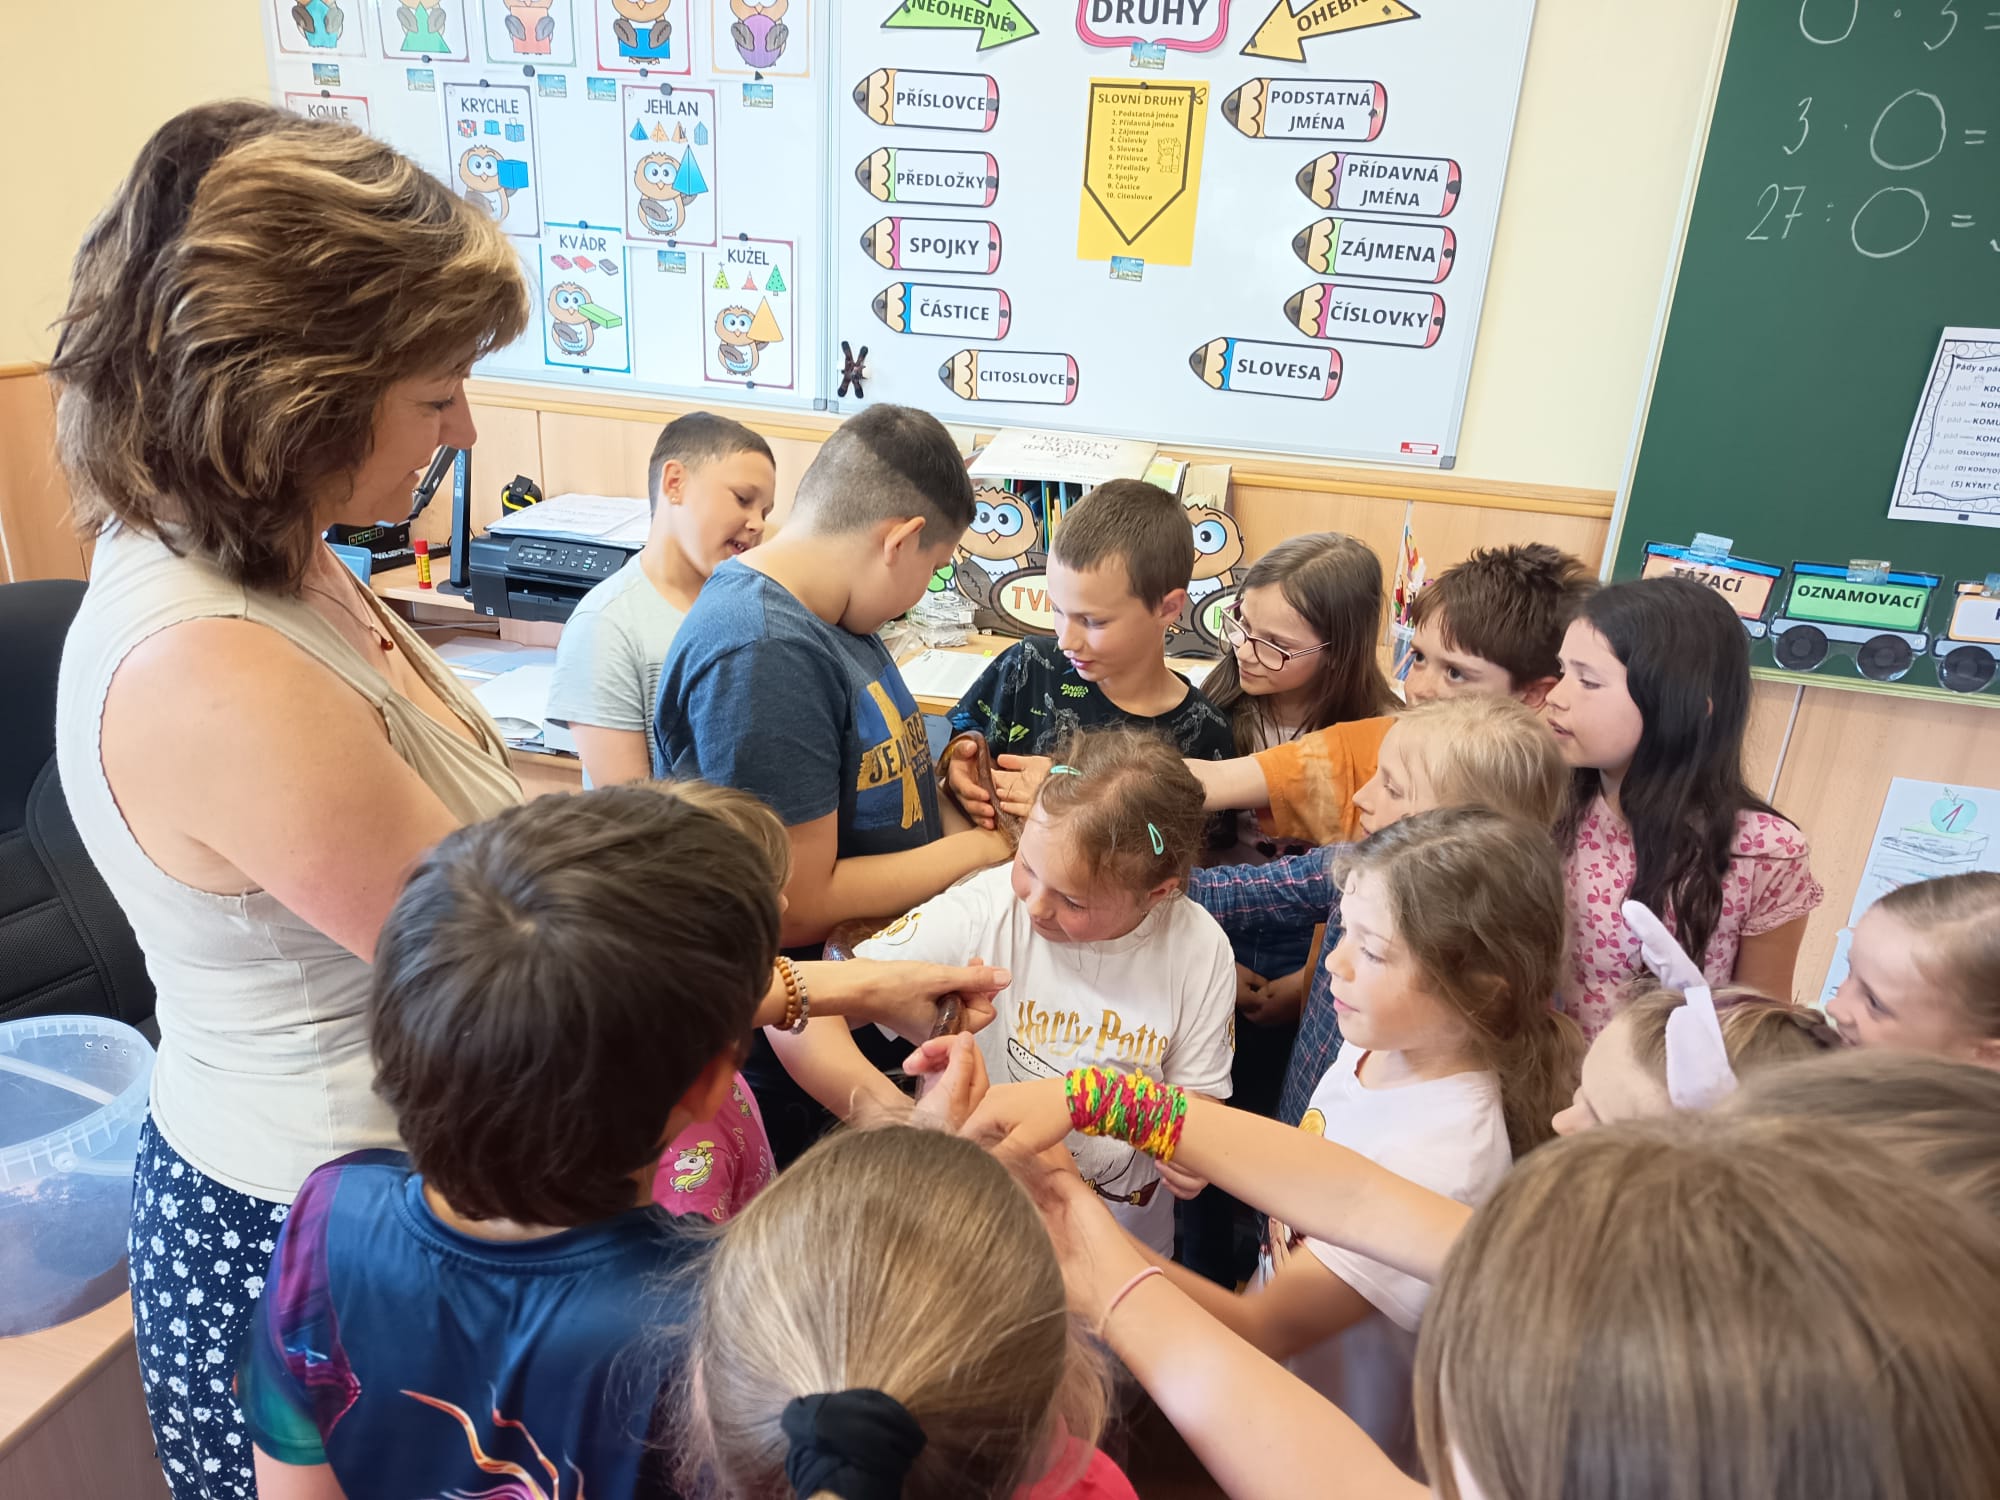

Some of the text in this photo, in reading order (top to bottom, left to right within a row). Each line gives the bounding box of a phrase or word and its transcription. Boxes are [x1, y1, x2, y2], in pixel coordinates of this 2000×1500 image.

[912, 0, 1011, 32] NEOHEBNÉ
[1091, 0, 1206, 26] DRUHY
[460, 97, 520, 115] KRYCHLE
[644, 98, 699, 117] JEHLAN
[896, 88, 985, 111] PŘÍSLOVCE
[1097, 93, 1185, 106] SLOVNÍ DRUHY
[1271, 89, 1371, 107] PODSTATNÁ
[1289, 113, 1345, 132] JMÉNA
[897, 169, 986, 189] PŘEDLOŽKY
[1348, 160, 1440, 183] PŘÍDAVNÁ
[1359, 188, 1421, 207] JMÉNA
[559, 233, 607, 252] KVÁDR
[909, 237, 980, 258] SPOJKY
[1341, 236, 1437, 263] ZÁJMENA
[727, 246, 770, 266] KUŽEL
[919, 298, 990, 321] ČÁSTICE
[1330, 301, 1430, 329] ČÍSLOVKY
[979, 370, 1066, 386] CITOSLOVCE
[1236, 358, 1322, 382] SLOVESA
[1673, 566, 1746, 593] TÁZACÍ
[1797, 584, 1923, 609] OZNAMOVACÍ
[1013, 1000, 1093, 1057] Harry
